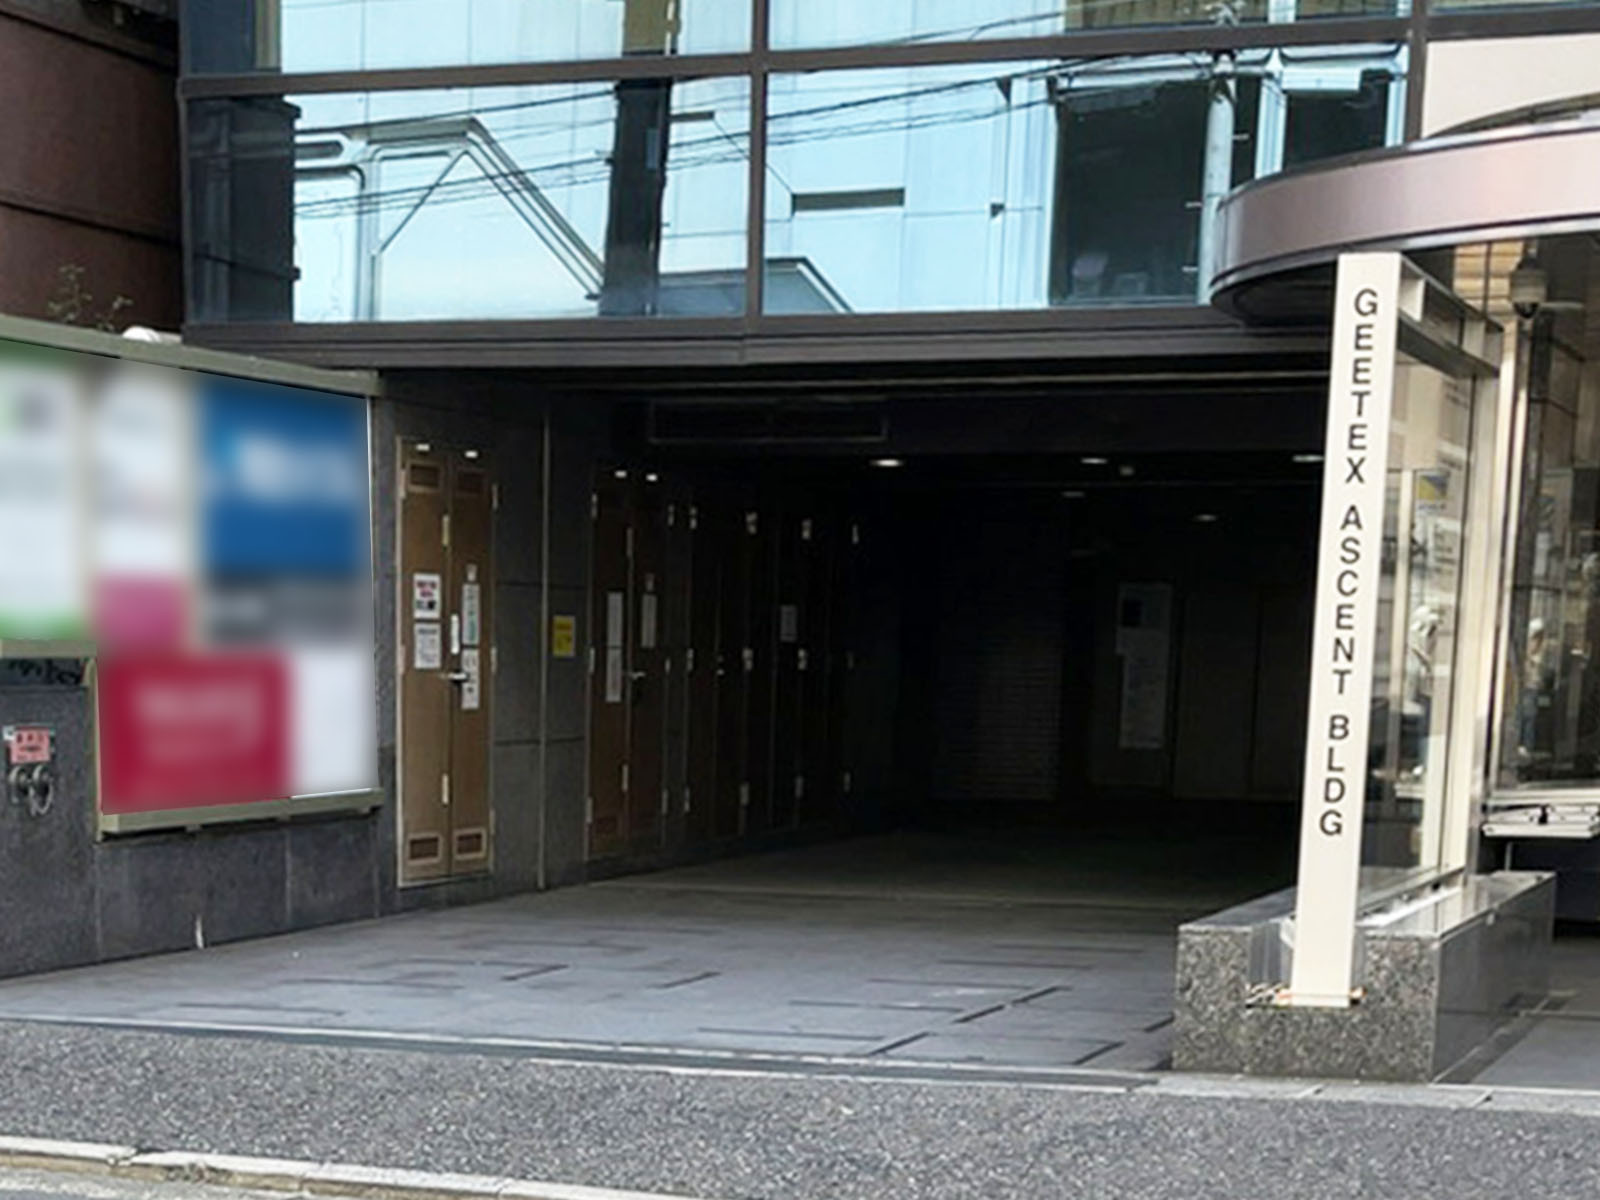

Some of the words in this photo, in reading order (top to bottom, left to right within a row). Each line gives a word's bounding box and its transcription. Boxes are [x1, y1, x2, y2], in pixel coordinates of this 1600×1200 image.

[1346, 288, 1378, 484] GEETEX
[1333, 505, 1363, 695] ASCENT
[1319, 715, 1349, 837] BLDG
